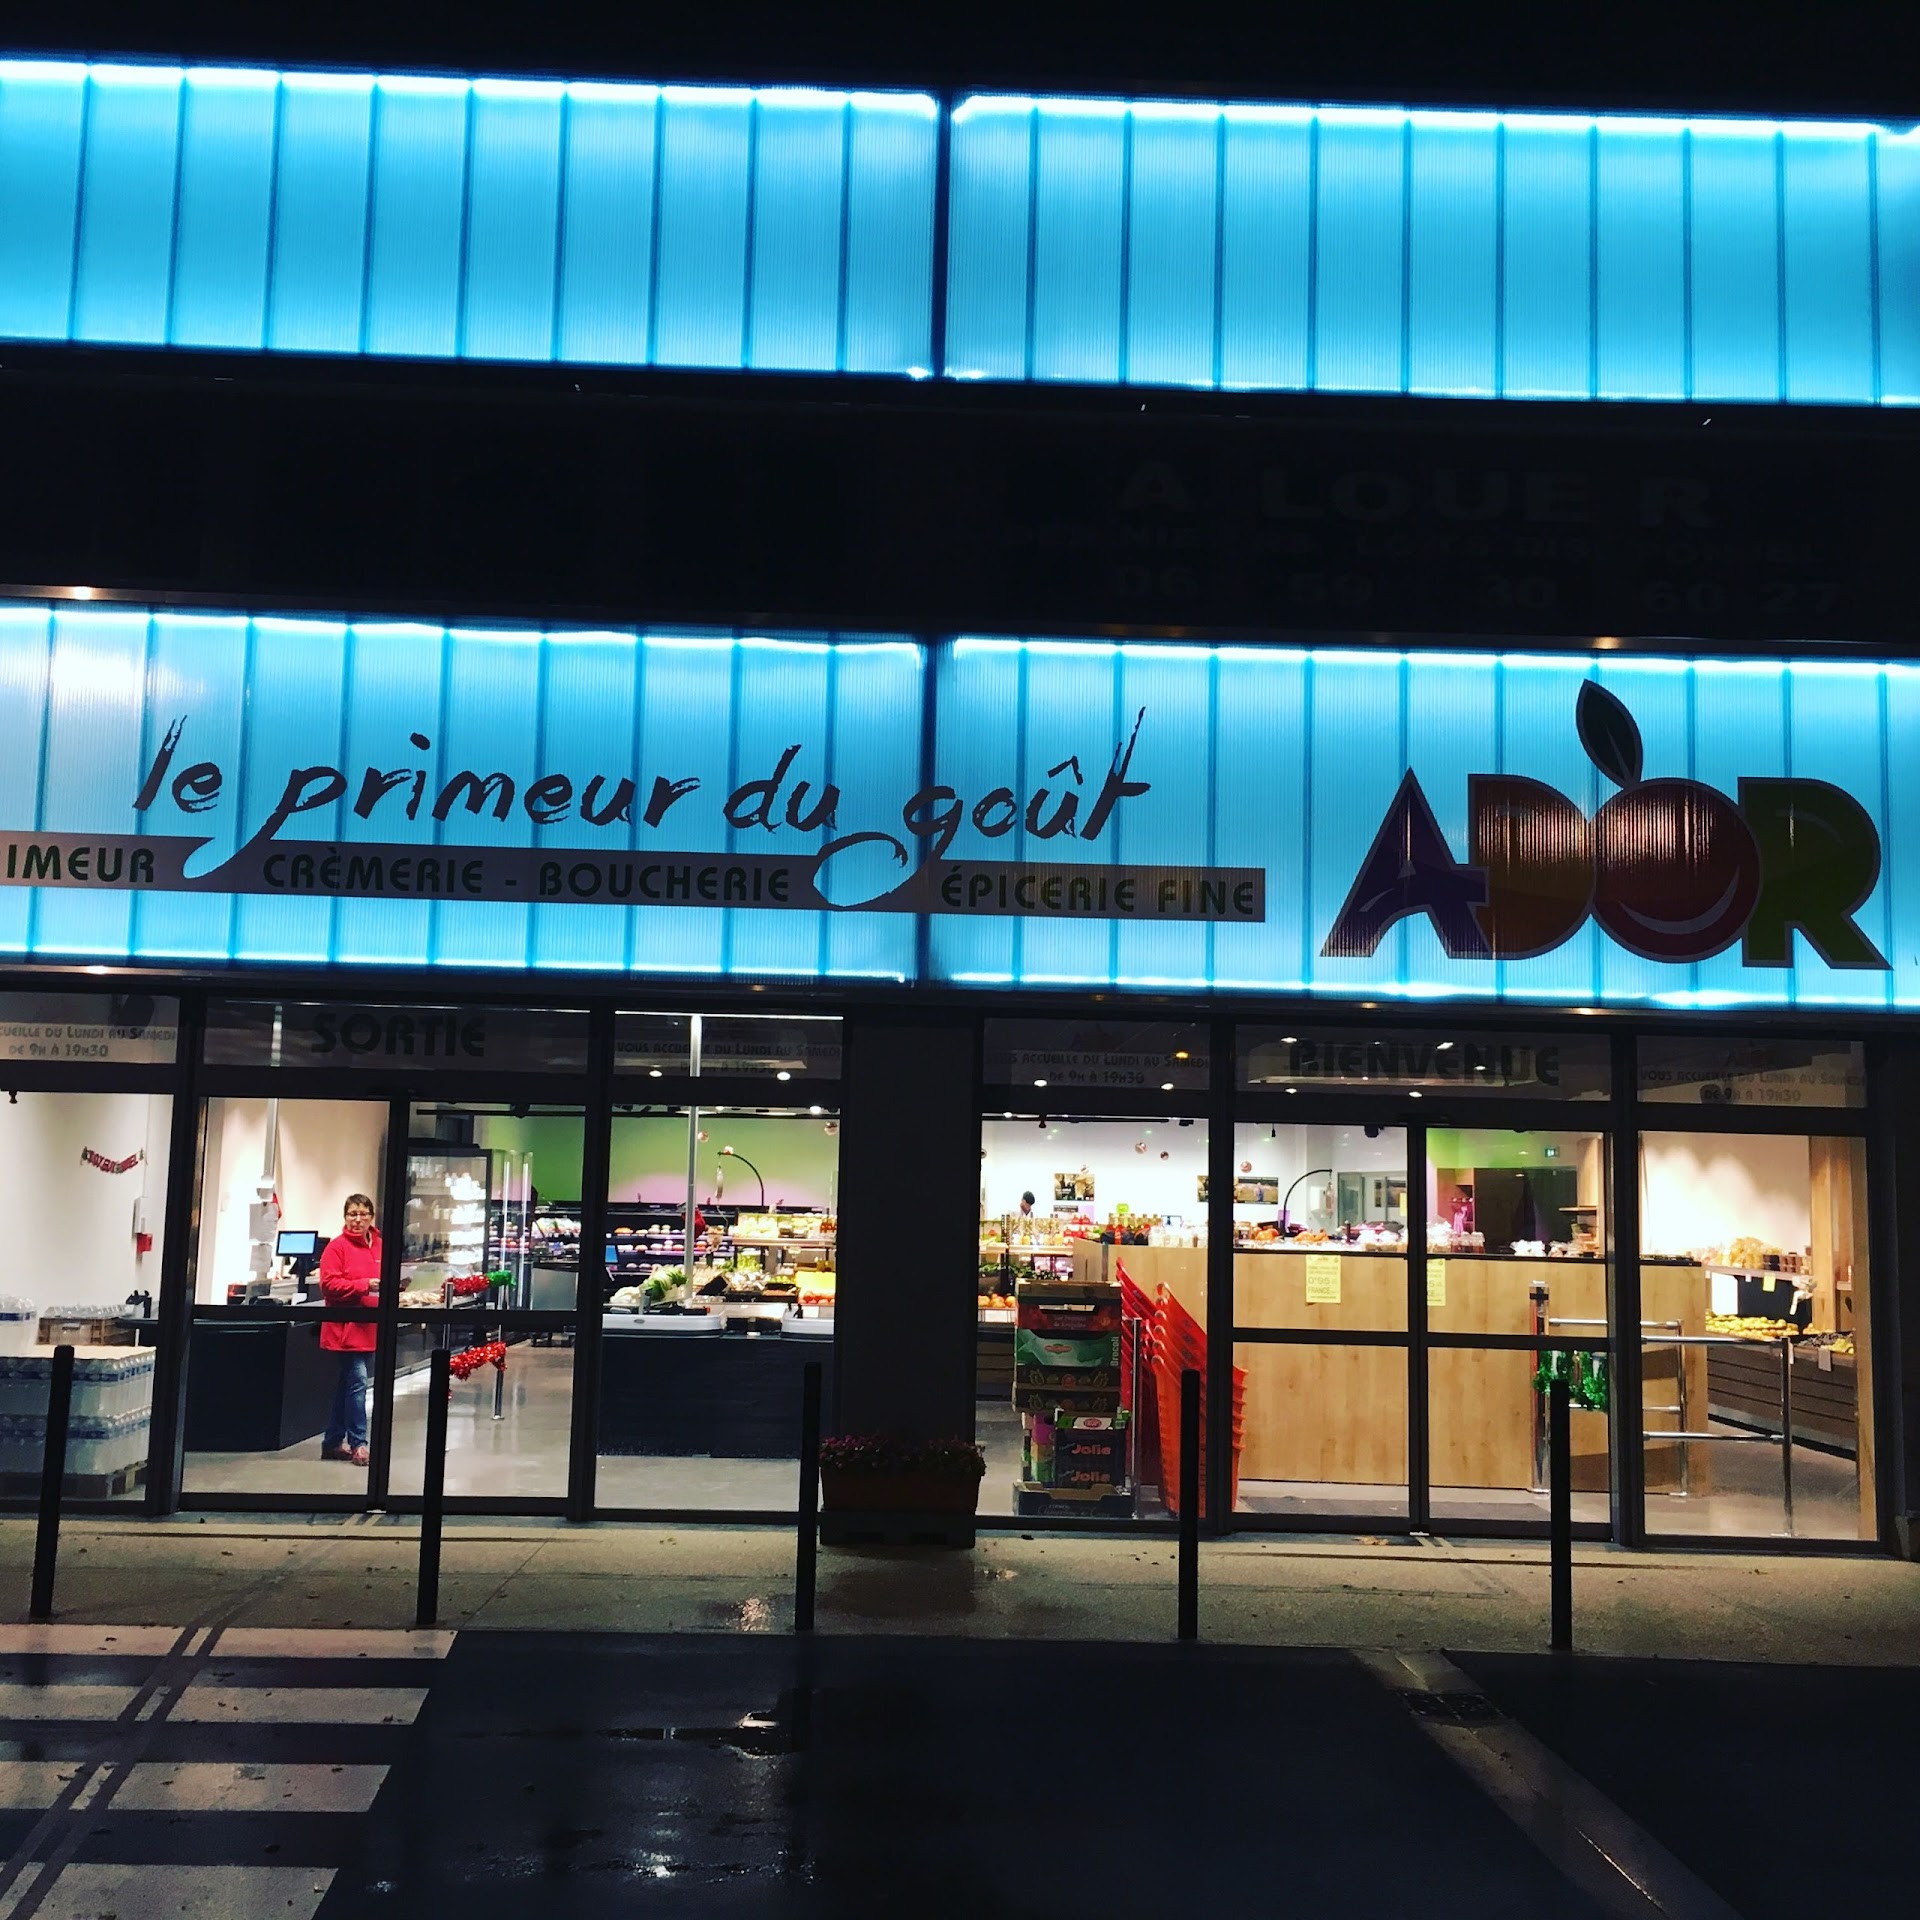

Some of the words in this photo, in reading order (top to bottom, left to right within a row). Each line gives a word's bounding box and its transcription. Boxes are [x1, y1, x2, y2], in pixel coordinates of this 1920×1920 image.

[133, 715, 223, 813] le
[270, 732, 701, 842] primeur
[722, 744, 841, 834] du
[902, 706, 1152, 860] goût
[263, 847, 484, 894] CRÈMERIE
[538, 861, 790, 903] BOUCHERIE
[941, 865, 1136, 911] ÉPICERIE
[1156, 879, 1254, 916] FINE
[45, 1028, 63, 1038] DU
[67, 1026, 104, 1039] LUNDI
[311, 1012, 487, 1058] SORTIE
[617, 1041, 649, 1053] VOUS
[735, 1043, 772, 1056] LUNDI
[1083, 1054, 1099, 1065] DU
[1144, 1055, 1160, 1068] AU
